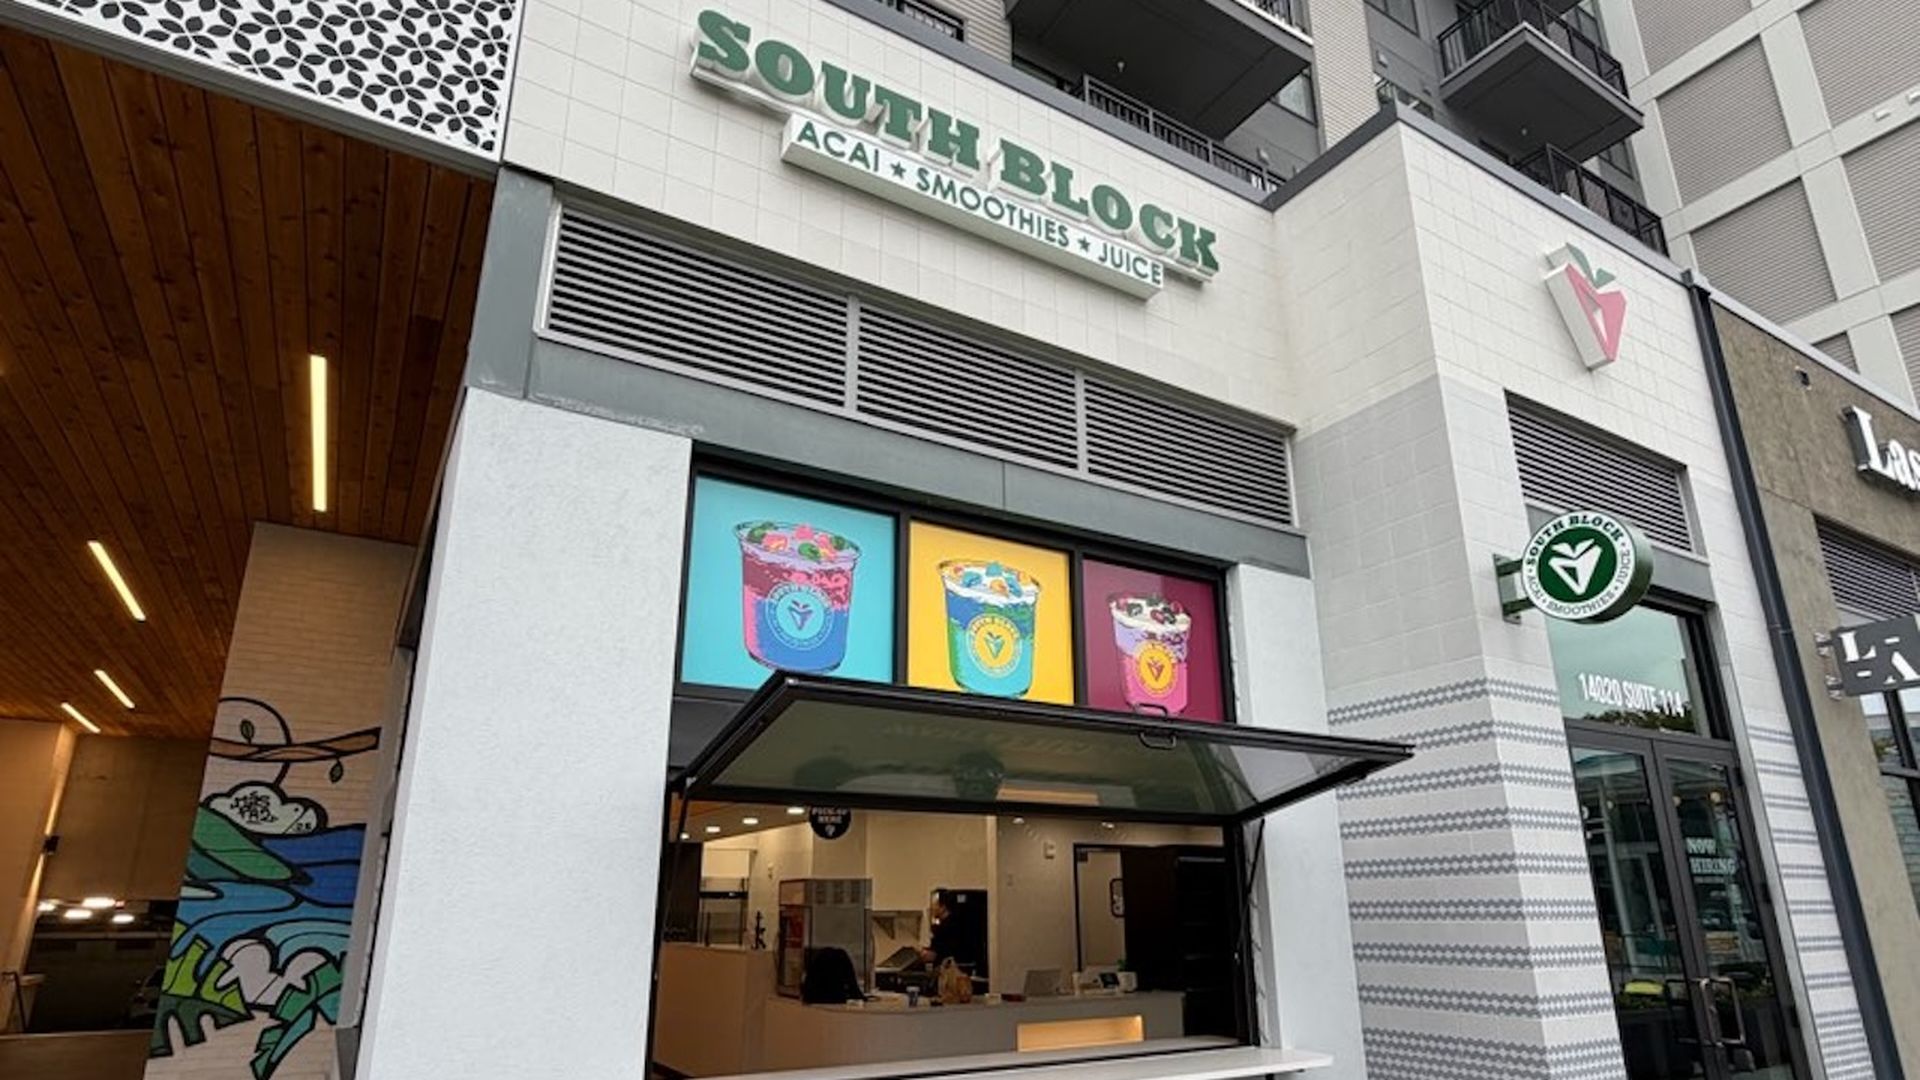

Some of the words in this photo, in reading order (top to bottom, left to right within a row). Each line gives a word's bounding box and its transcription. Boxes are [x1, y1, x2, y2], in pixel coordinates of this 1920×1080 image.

[697, 9, 980, 171] SOUTH
[1000, 138, 1219, 271] BLOCK
[797, 121, 880, 173] ACAI
[916, 167, 1070, 248] SMOOTHIES
[1098, 242, 1162, 286] JUICE
[1526, 520, 1565, 566] SOUTH
[1569, 515, 1625, 542] BLOCK
[1547, 592, 1616, 616] SMOOTHIES
[1617, 549, 1631, 585] JUICE
[1578, 673, 1623, 707] 14020
[1622, 680, 1661, 714] SUITE
[1658, 689, 1685, 718] 114
